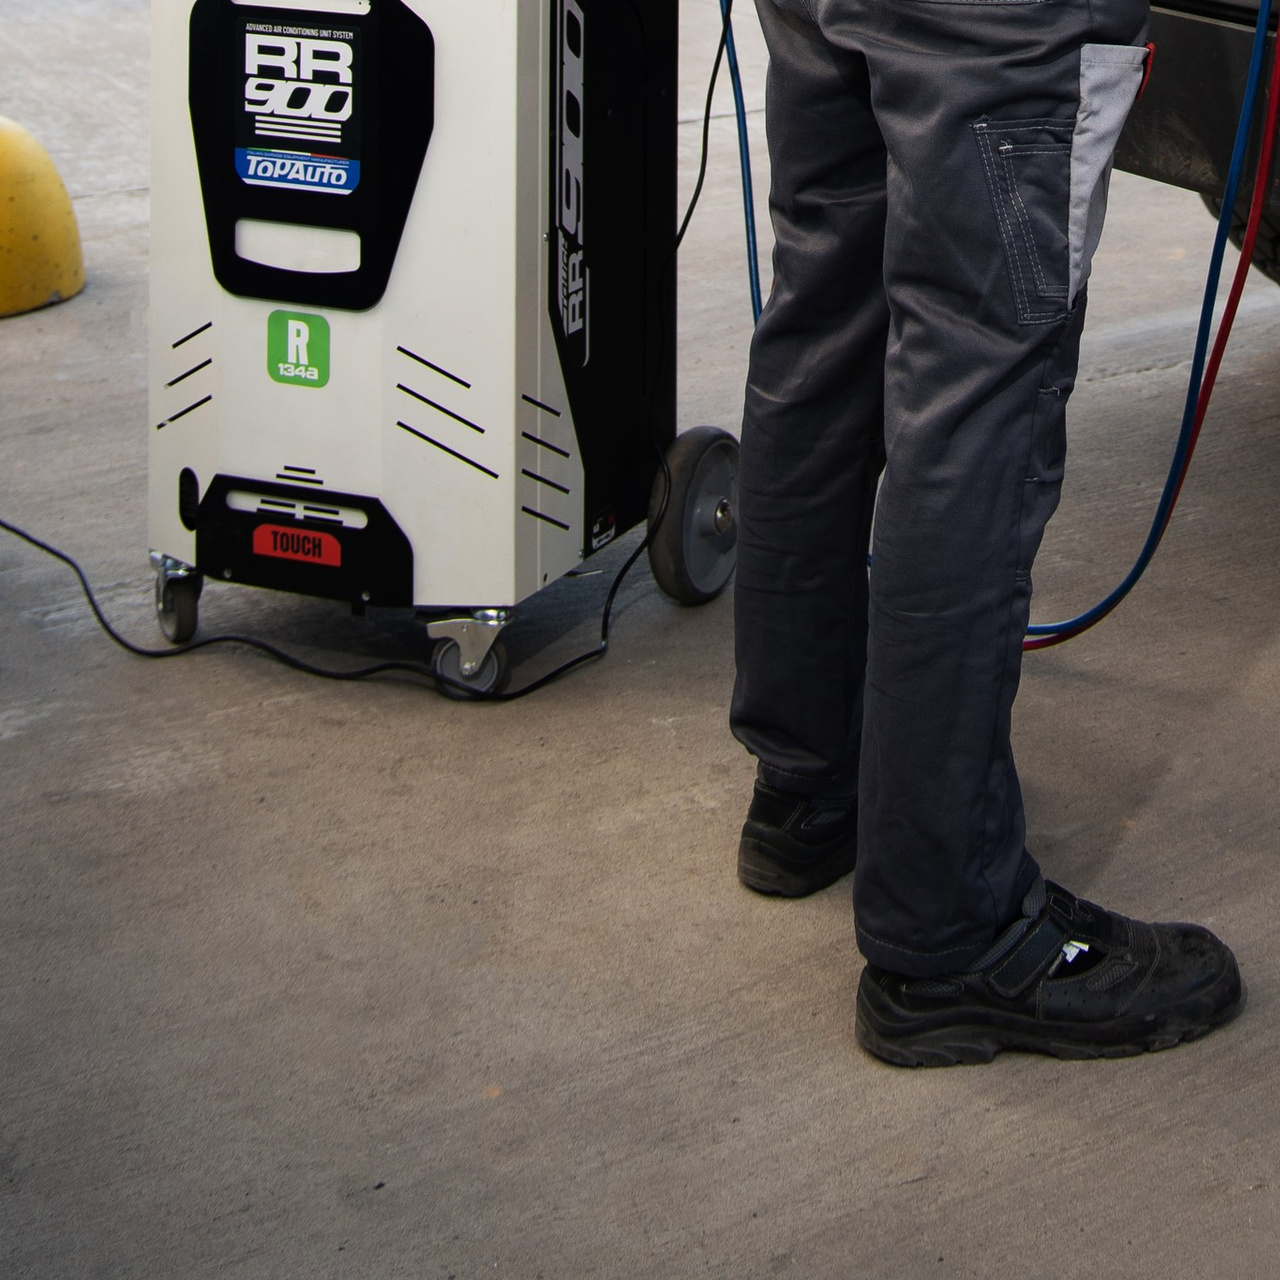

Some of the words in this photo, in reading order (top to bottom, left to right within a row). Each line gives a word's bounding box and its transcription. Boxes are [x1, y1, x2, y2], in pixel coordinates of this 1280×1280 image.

[245, 22, 273, 33] ADVANCED
[273, 25, 282, 34] AIR
[283, 26, 319, 37] CONDITIONING
[319, 29, 332, 38] UNIT
[332, 30, 354, 40] SYSTEM
[245, 33, 353, 84] RR
[245, 77, 352, 122] 900
[568, 249, 583, 335] RR
[287, 319, 309, 366] R
[278, 362, 319, 380] 134a
[271, 529, 322, 558] TOUCH
